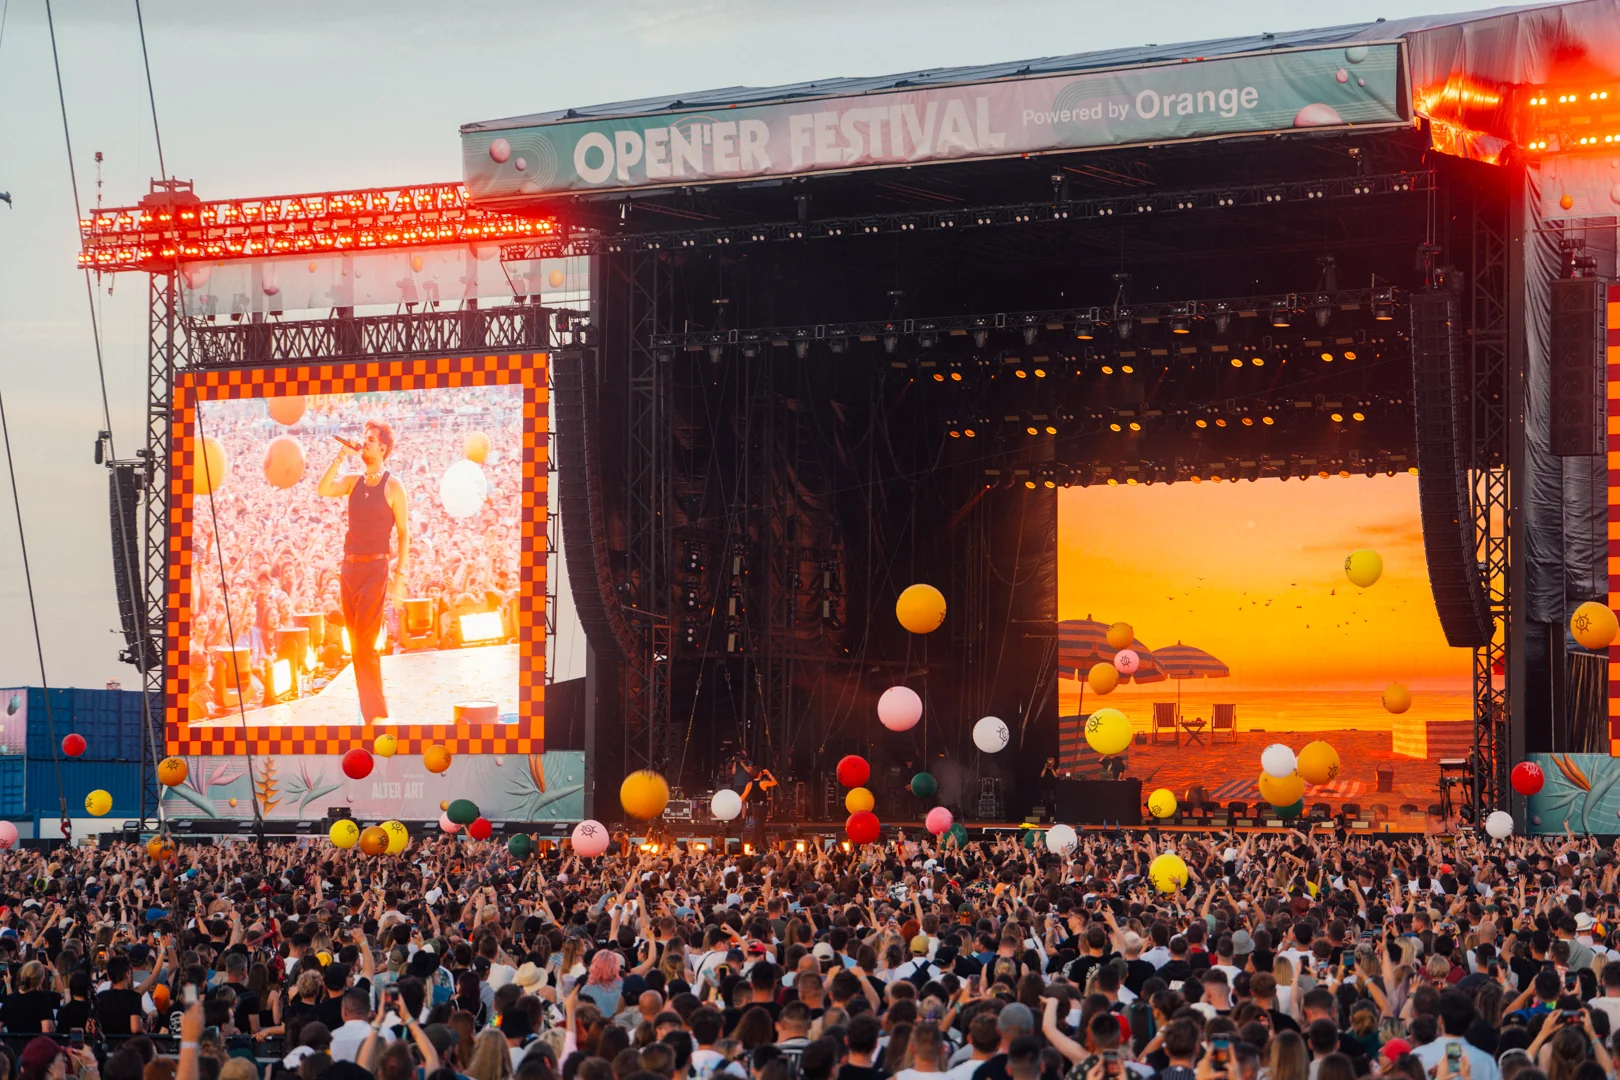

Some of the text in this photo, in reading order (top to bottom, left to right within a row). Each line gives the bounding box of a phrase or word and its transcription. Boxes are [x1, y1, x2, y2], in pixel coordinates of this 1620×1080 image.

[1023, 86, 1259, 126] Powered by Orange
[573, 96, 1006, 184] OPEN'ER FESTIVAL
[371, 781, 424, 799] ALTER ART
